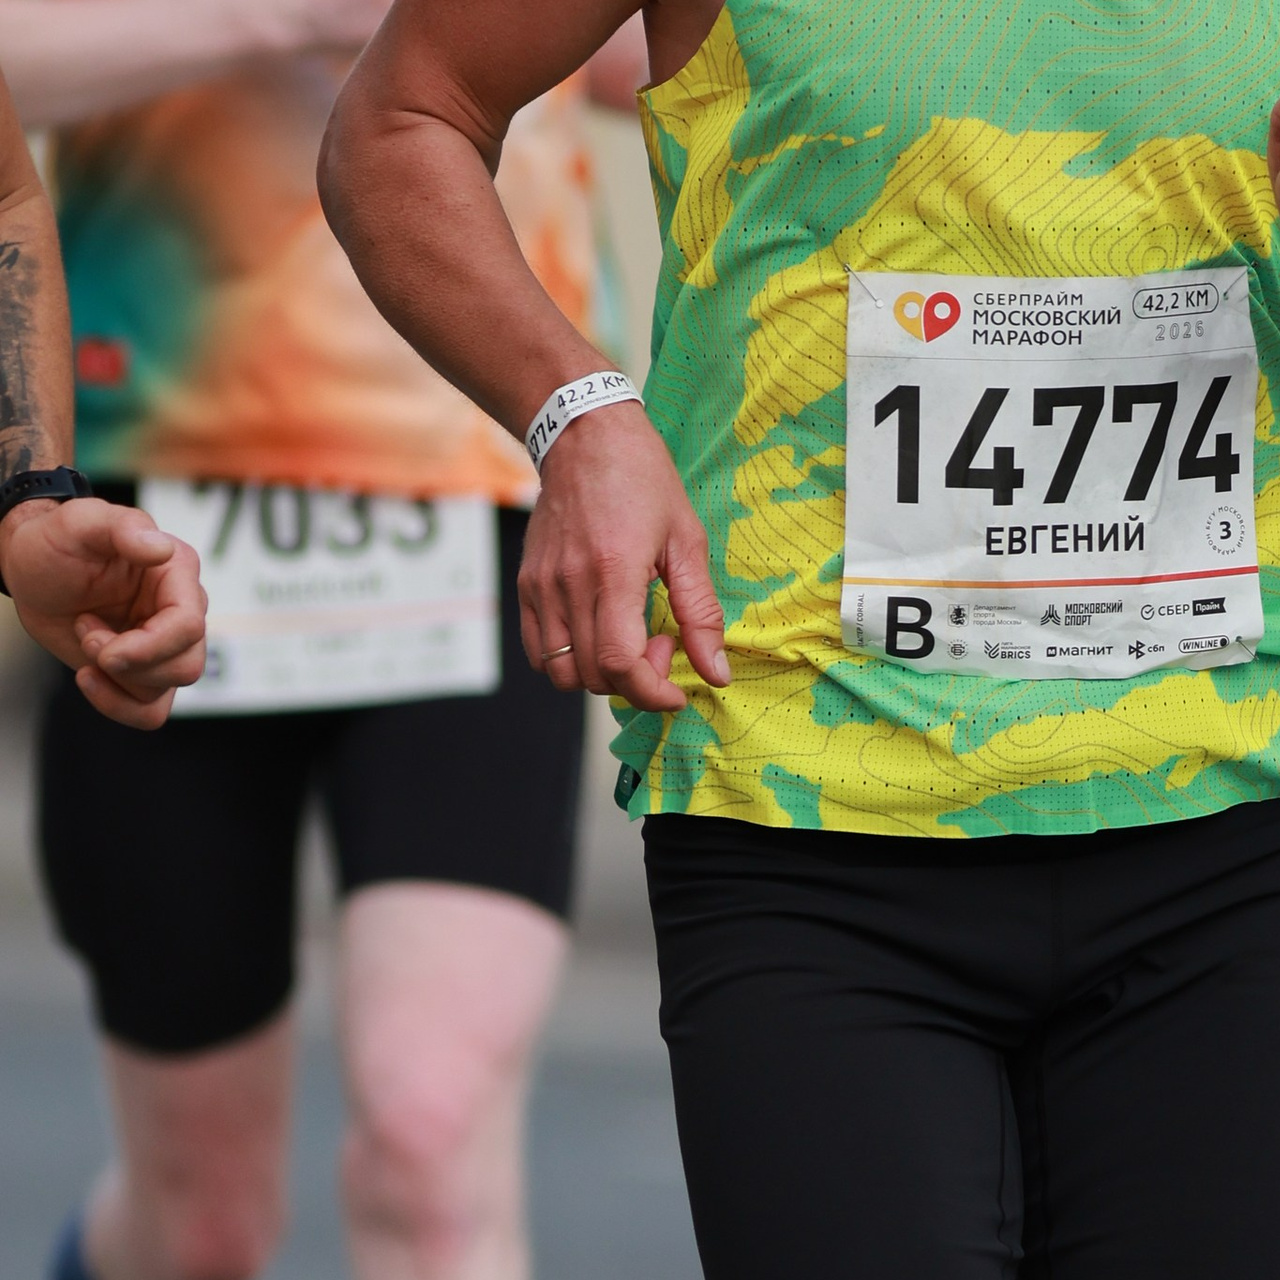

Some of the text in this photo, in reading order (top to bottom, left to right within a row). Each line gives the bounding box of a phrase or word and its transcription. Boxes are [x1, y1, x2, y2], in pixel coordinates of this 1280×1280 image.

[973, 292, 1083, 306] СБЕРПРАЙМ
[1142, 289, 1209, 313] 42,2 КМ
[973, 306, 1121, 326] МОСКОВСКИЙ
[972, 329, 1083, 346] МАРАФОН
[1155, 320, 1205, 341] 2026
[557, 376, 629, 409] 42,2 КМ
[874, 375, 1241, 506] 14774
[985, 515, 1145, 555] ЕВГЕНИЙ
[1219, 520, 1232, 540] 3
[1064, 600, 1123, 614] МОСКОВСКИЙ
[1158, 602, 1221, 616] СБЕР Прайм
[1064, 615, 1093, 626] СПОРТ
[1182, 639, 1219, 651] WINLINE
[1000, 650, 1031, 659] BRICS
